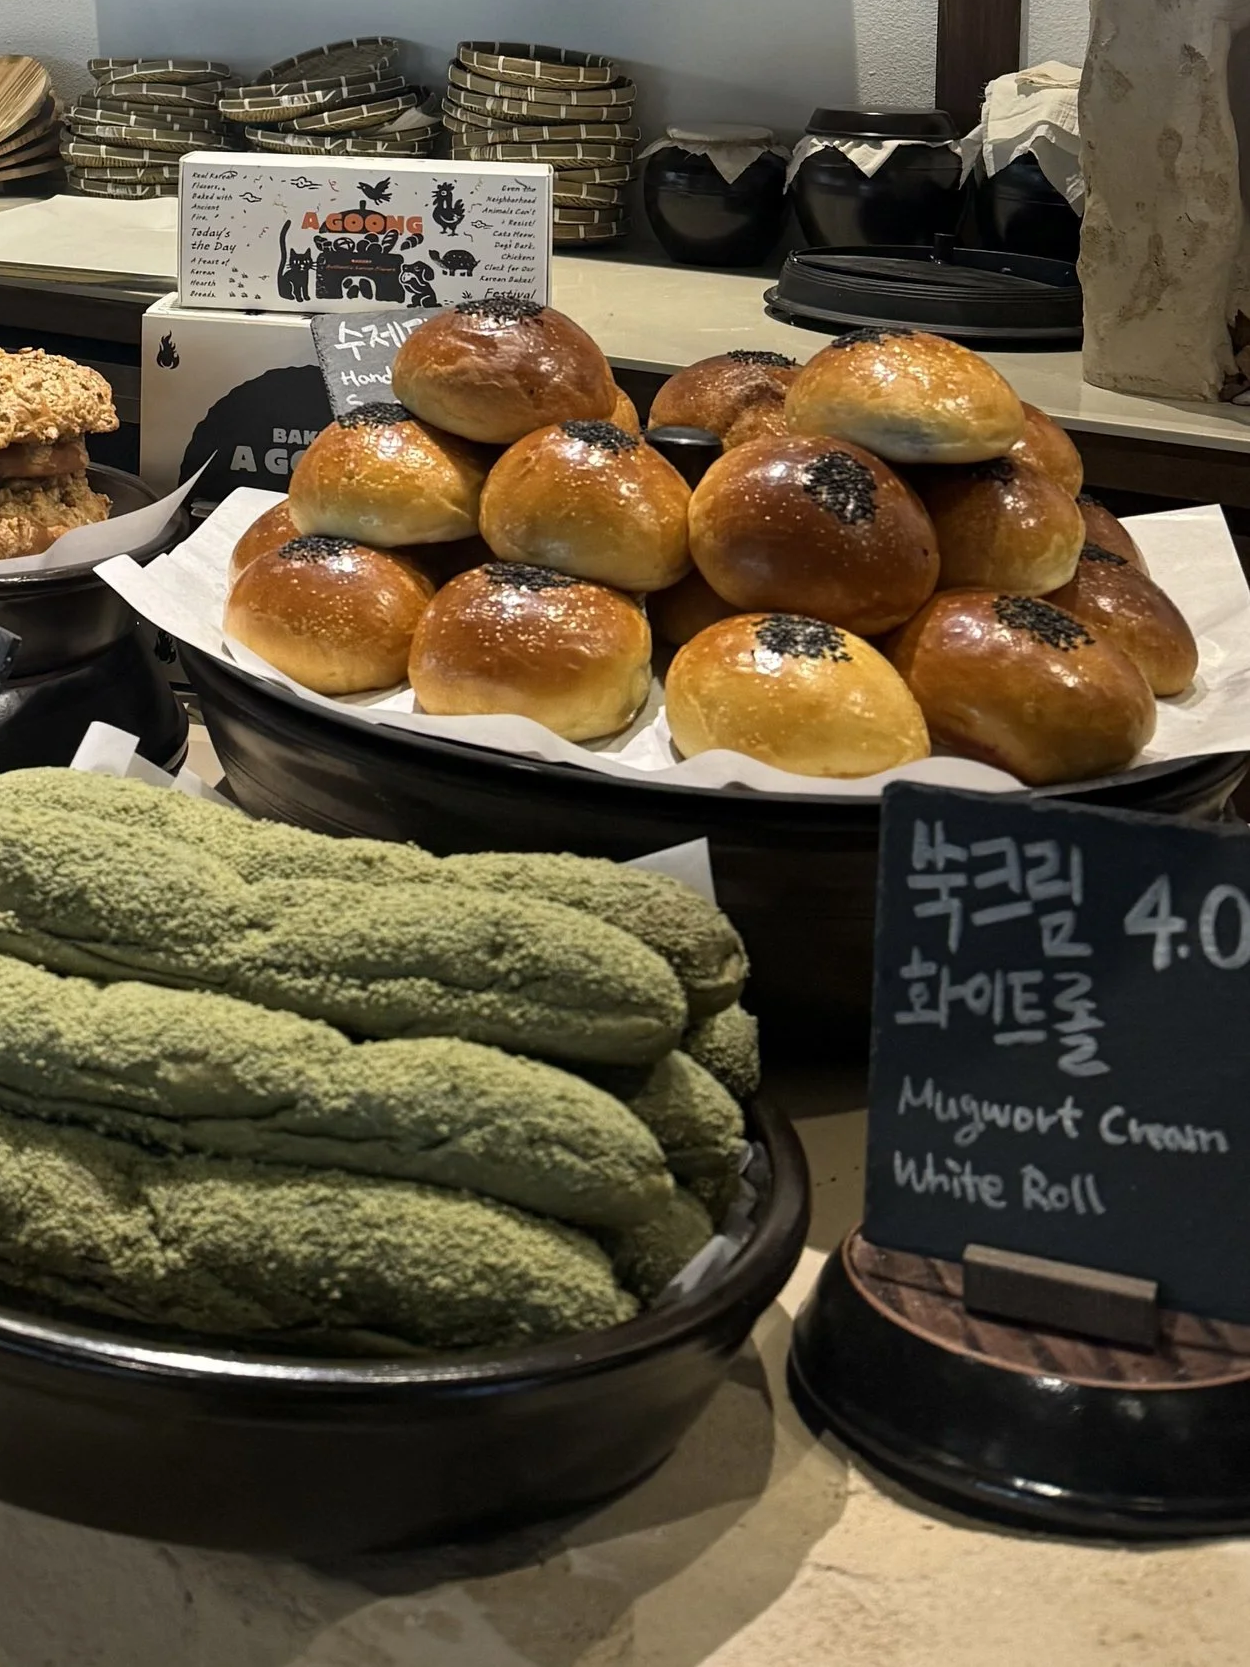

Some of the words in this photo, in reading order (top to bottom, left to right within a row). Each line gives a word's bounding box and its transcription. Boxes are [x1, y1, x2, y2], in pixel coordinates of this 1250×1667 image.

[191, 203, 220, 211] Ancient
[301, 211, 320, 231] A
[325, 212, 424, 236] GOONG
[191, 226, 231, 240] Today's
[191, 240, 211, 251] the
[214, 241, 237, 254] Day
[221, 258, 231, 266] of
[501, 253, 535, 261] Chickens
[191, 268, 215, 276] Korean
[507, 264, 519, 273] for
[190, 279, 216, 287] Hearth
[484, 287, 537, 300] Festival
[230, 445, 257, 472] A
[907, 819, 1093, 958] 쑥크림
[1123, 874, 1250, 971] 4.0
[895, 946, 1110, 1077] 화이트롤
[897, 1075, 1083, 1147] Mugwort
[1099, 1105, 1230, 1154] Cream
[893, 1150, 1008, 1210] White
[1022, 1164, 1107, 1215] Roll
